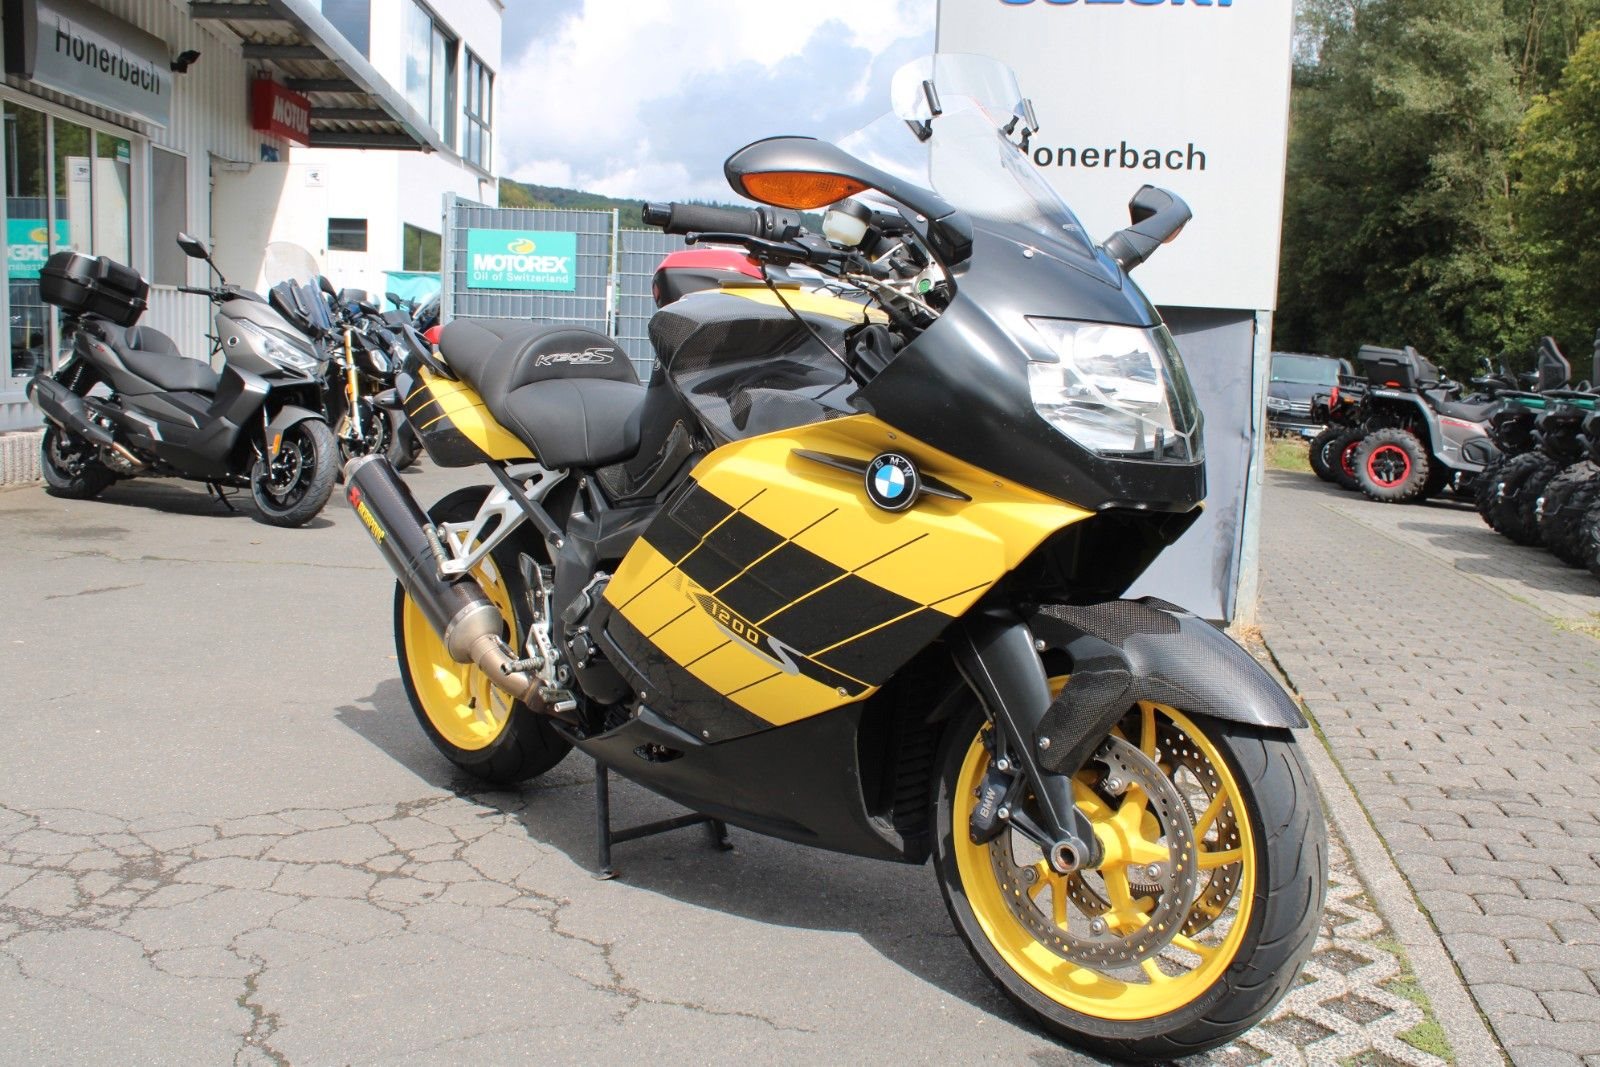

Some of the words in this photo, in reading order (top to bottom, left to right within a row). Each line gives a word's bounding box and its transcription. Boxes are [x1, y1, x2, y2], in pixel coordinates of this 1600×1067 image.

[272, 95, 309, 136] MOTUL
[1022, 141, 1207, 171] onerbach
[473, 253, 568, 272] MOTOREX
[473, 271, 488, 281] Oil
[491, 271, 503, 282] of
[506, 272, 569, 284] Switzerland
[874, 456, 913, 478] BMW
[711, 601, 759, 645] 1200
[980, 787, 996, 819] BMW
